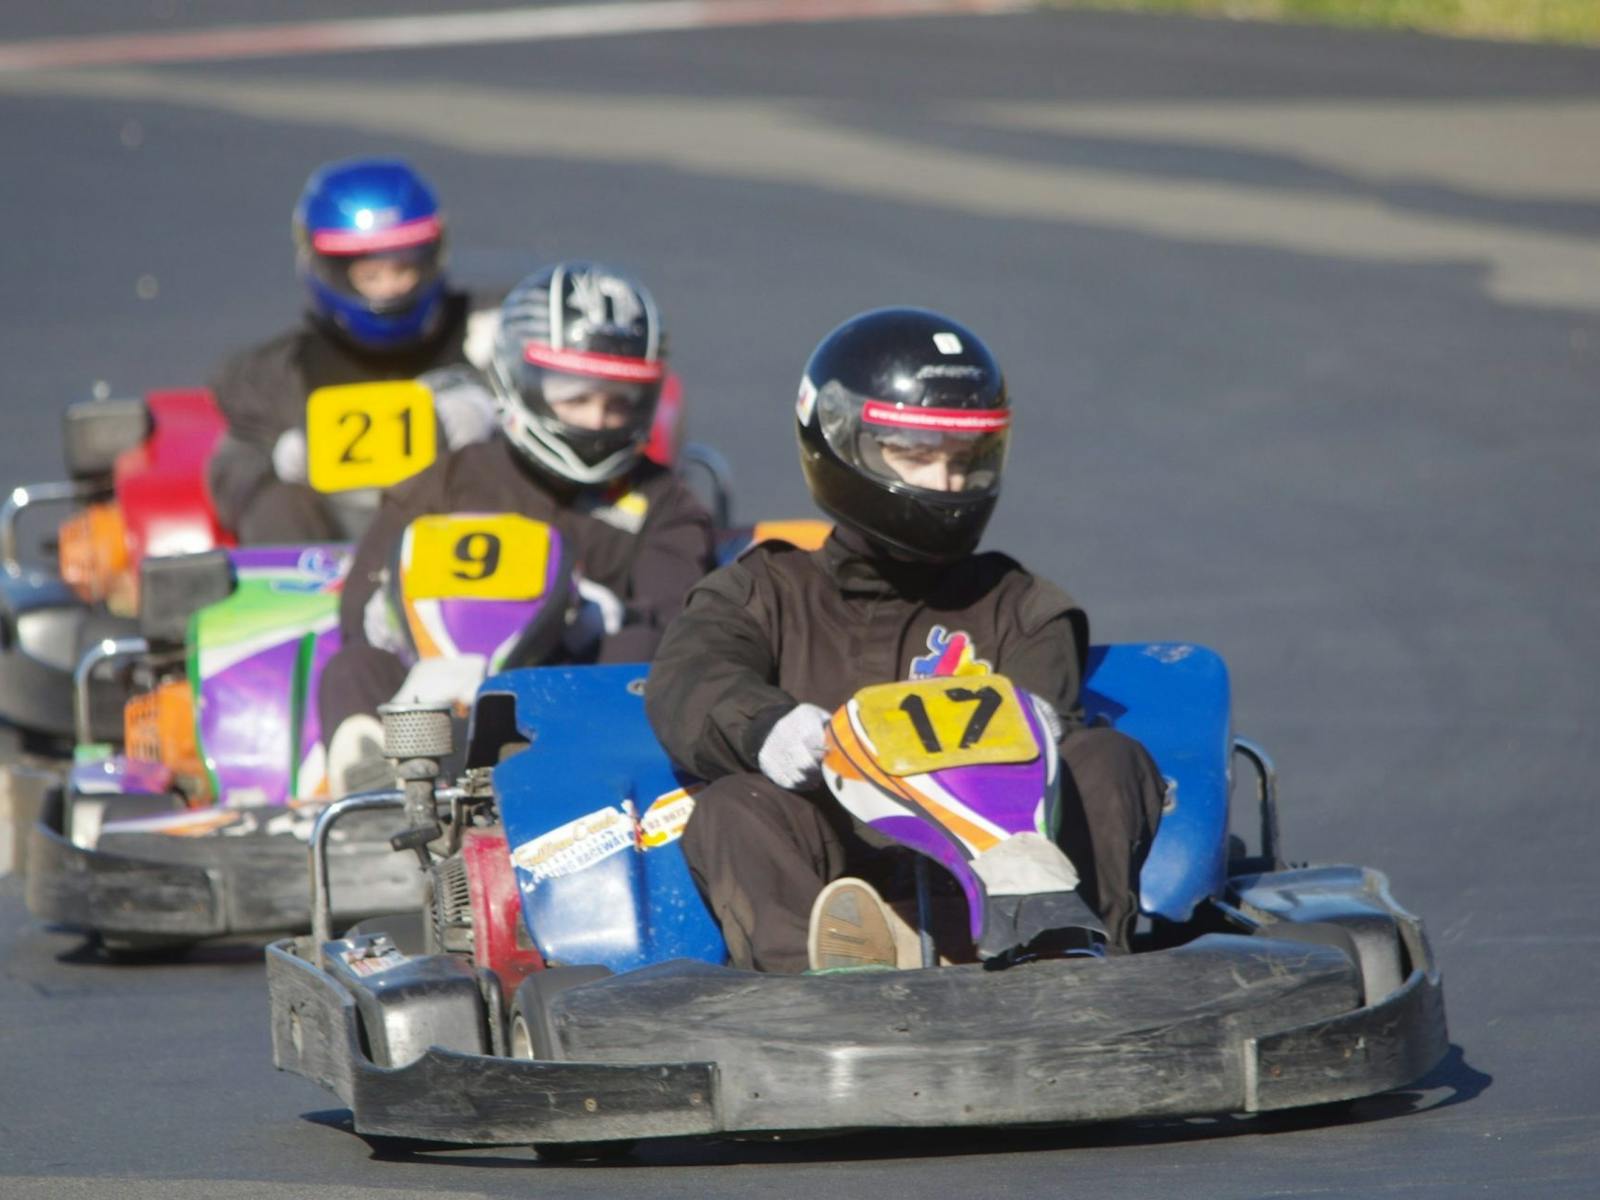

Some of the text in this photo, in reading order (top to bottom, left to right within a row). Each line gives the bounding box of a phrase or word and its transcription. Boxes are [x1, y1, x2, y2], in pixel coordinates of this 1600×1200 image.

[338, 407, 412, 464] 21
[452, 532, 502, 582] 9
[899, 686, 1003, 754] 17
